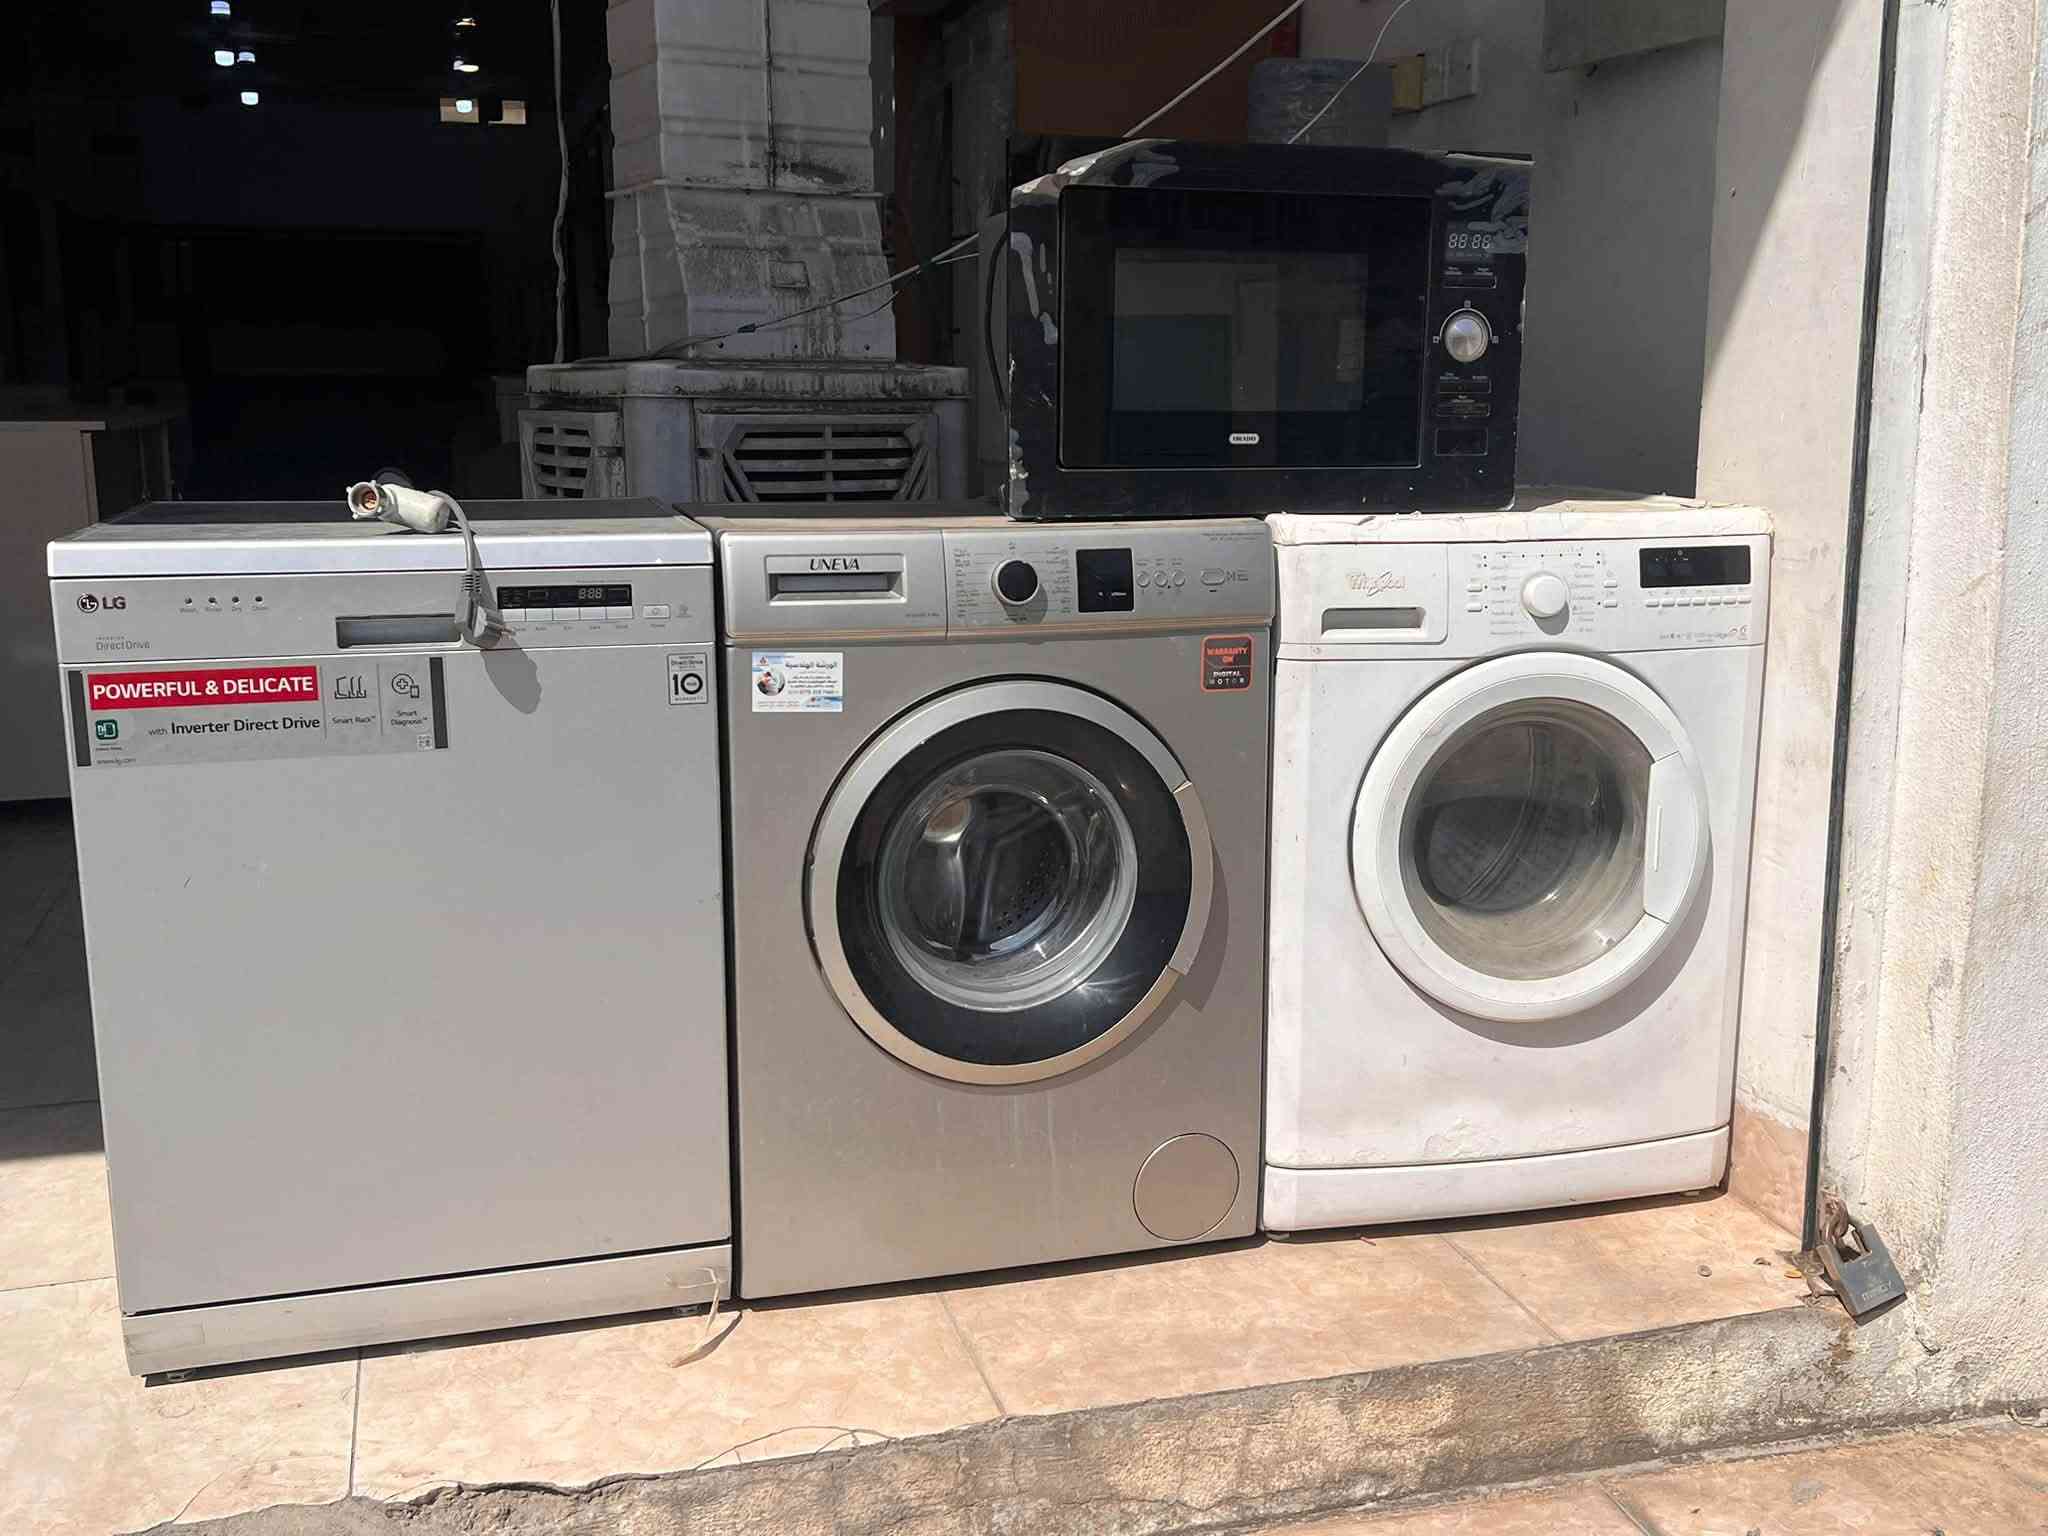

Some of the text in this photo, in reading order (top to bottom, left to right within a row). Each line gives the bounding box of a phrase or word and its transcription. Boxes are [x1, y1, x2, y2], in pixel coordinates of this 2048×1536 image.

[809, 557, 860, 571] UNEVA
[101, 595, 127, 609] LG
[93, 676, 313, 700] POWERFUL & DELICATE
[672, 673, 703, 695] 10
[148, 716, 320, 736] with Inverter Direct Drive
